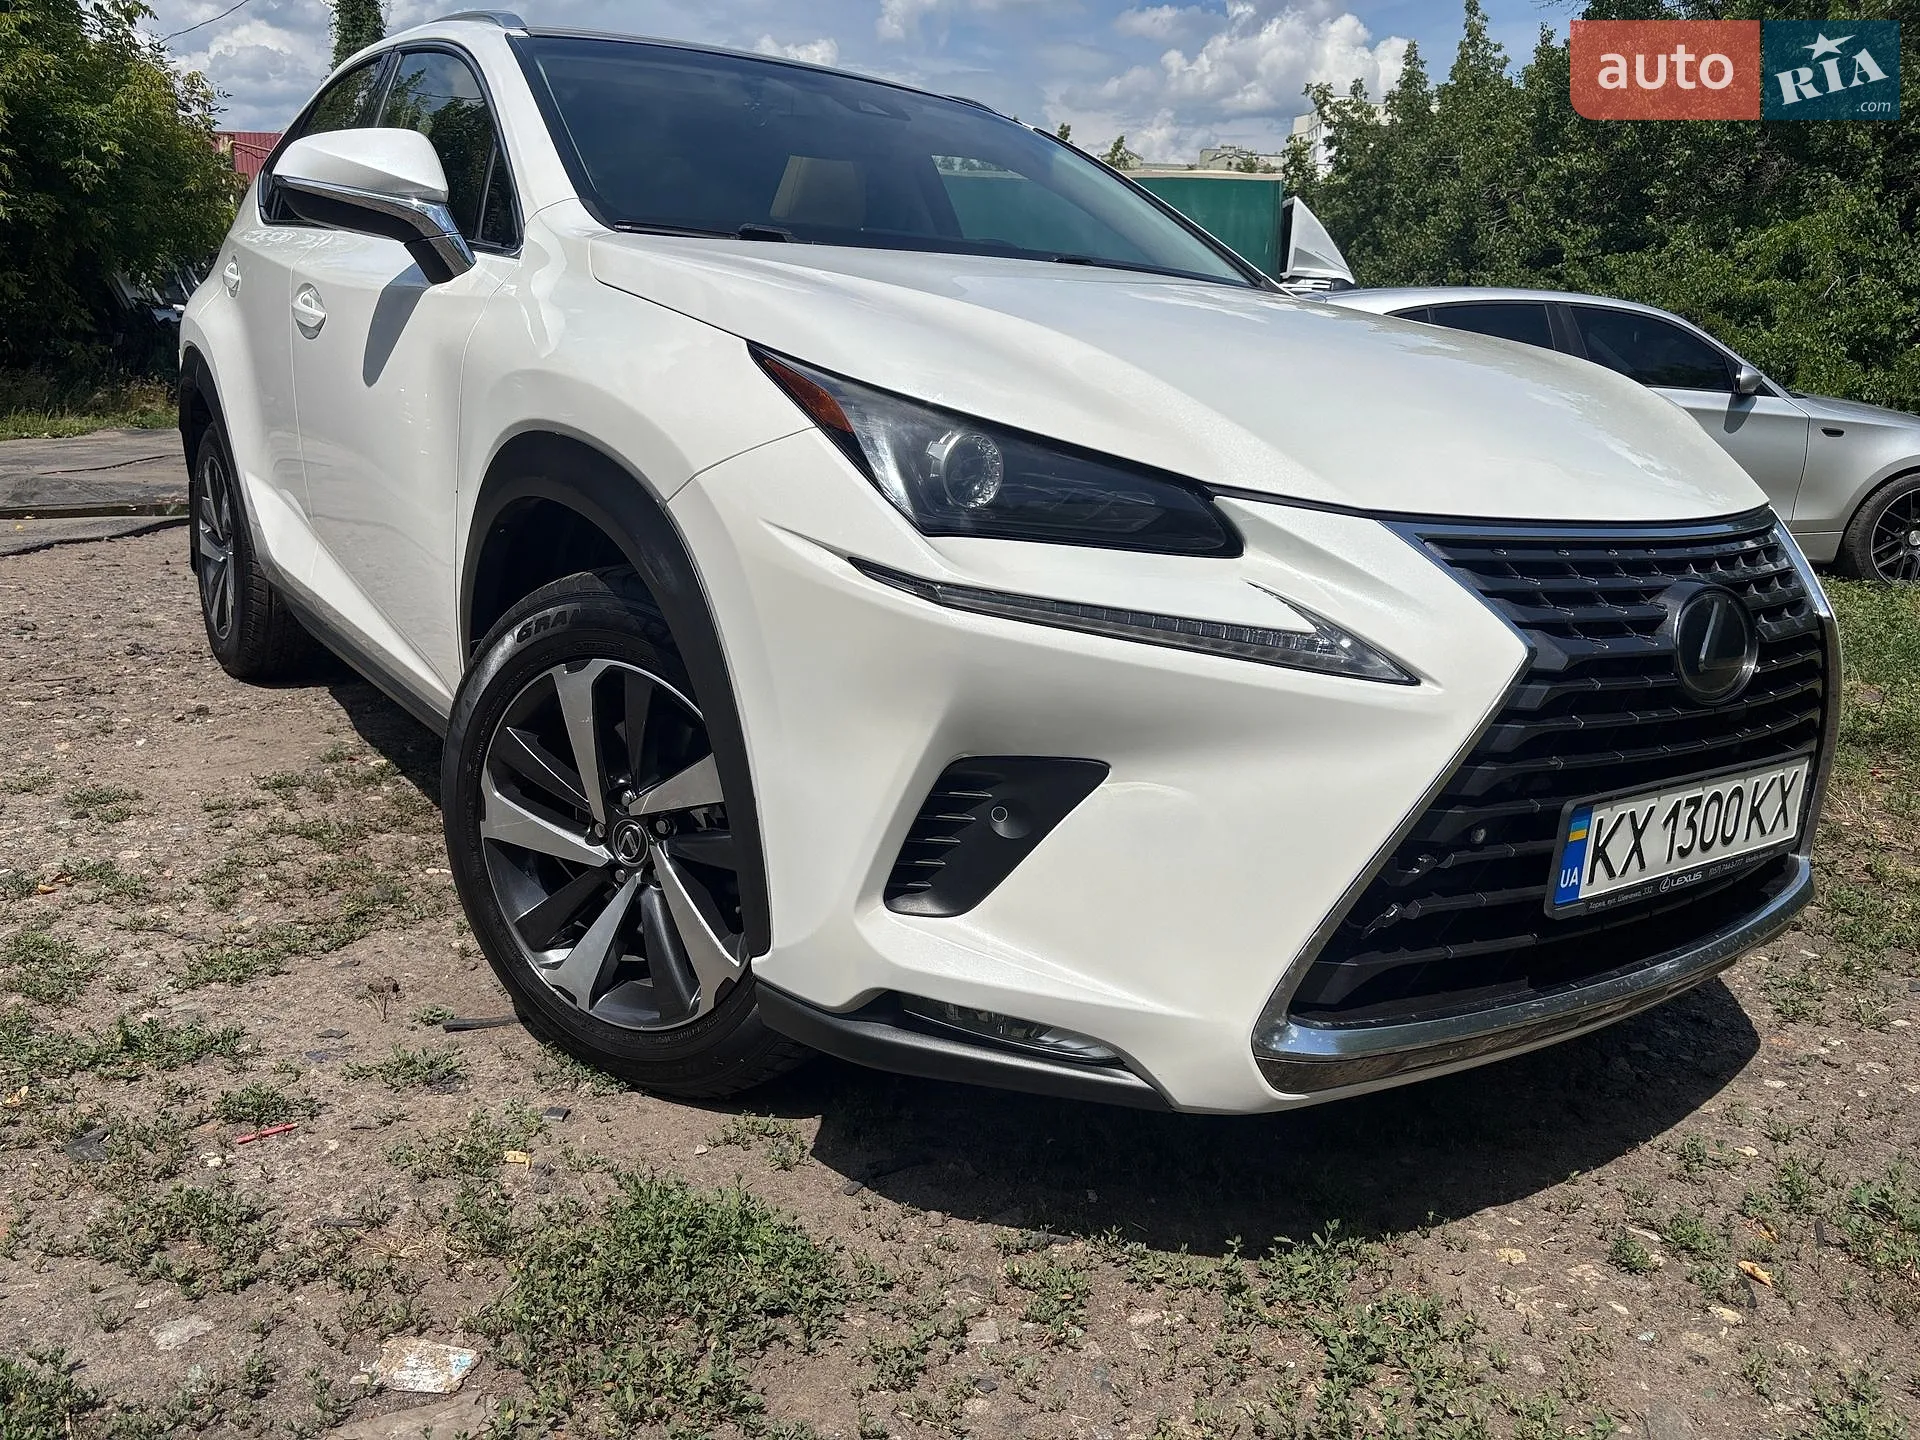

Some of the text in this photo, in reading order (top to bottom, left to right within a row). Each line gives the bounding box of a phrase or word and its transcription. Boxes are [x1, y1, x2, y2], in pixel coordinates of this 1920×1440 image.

[1586, 769, 1799, 885] KX 1300 KX
[1560, 867, 1579, 889] UA
[1671, 871, 1702, 887] LEXUS
